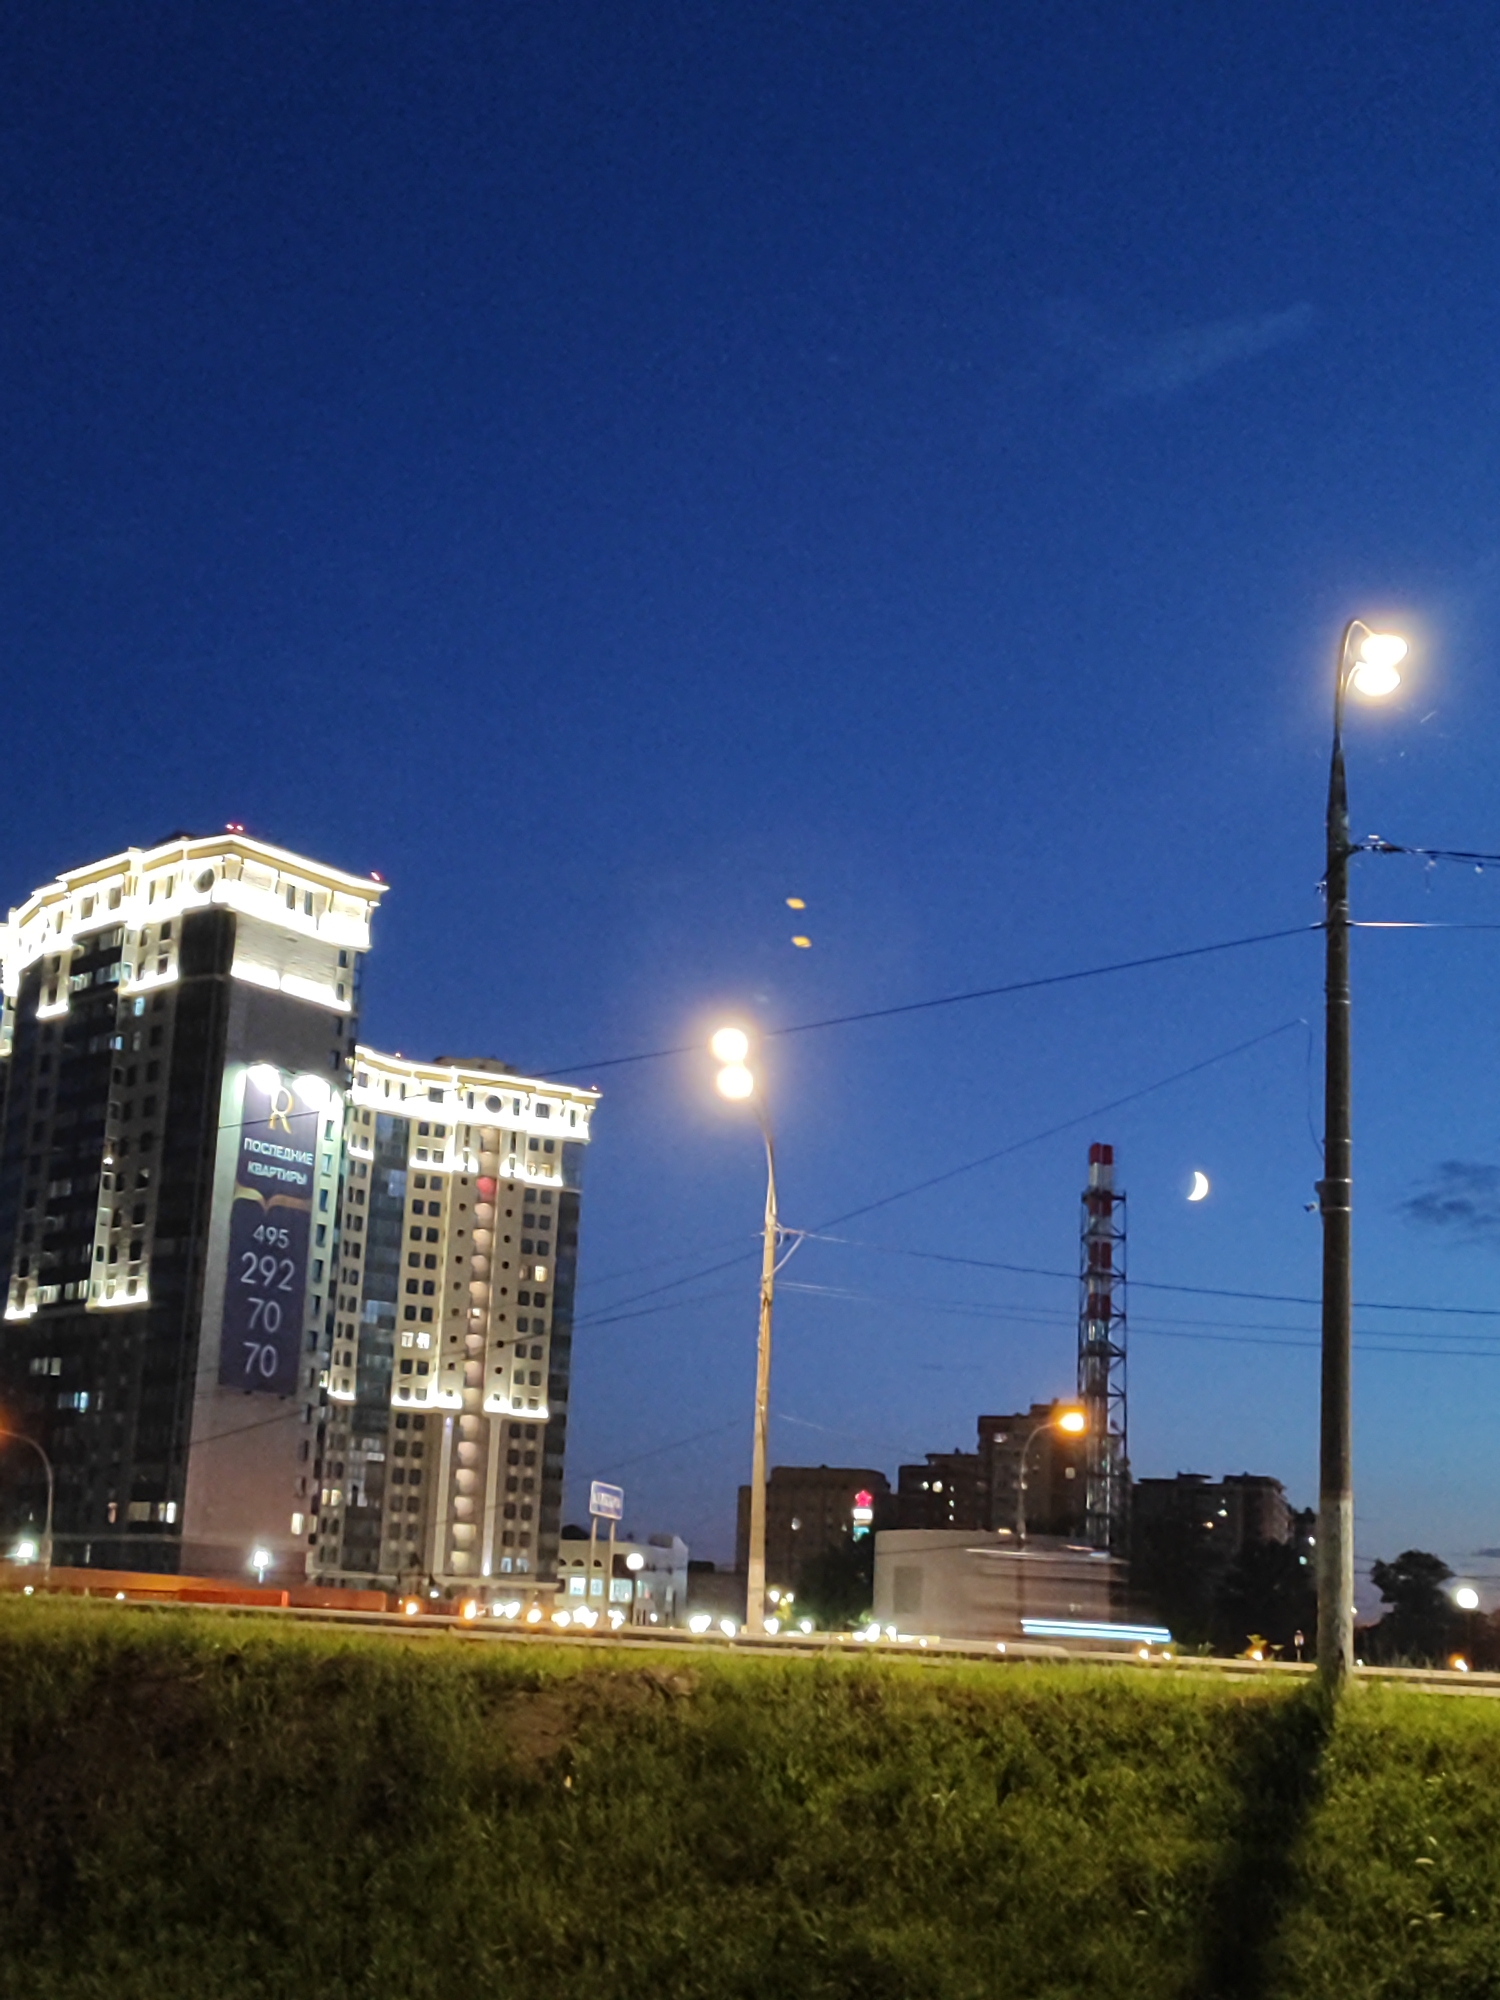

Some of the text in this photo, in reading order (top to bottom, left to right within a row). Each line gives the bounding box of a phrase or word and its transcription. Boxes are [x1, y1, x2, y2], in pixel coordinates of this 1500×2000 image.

[243, 1137, 315, 1166] ПОСЛЕДНИЕ
[247, 1160, 308, 1186] КВАРТИРЫ
[252, 1224, 291, 1249] 495
[240, 1251, 296, 1291] 292
[247, 1296, 282, 1333] 70
[243, 1341, 278, 1378] 70
